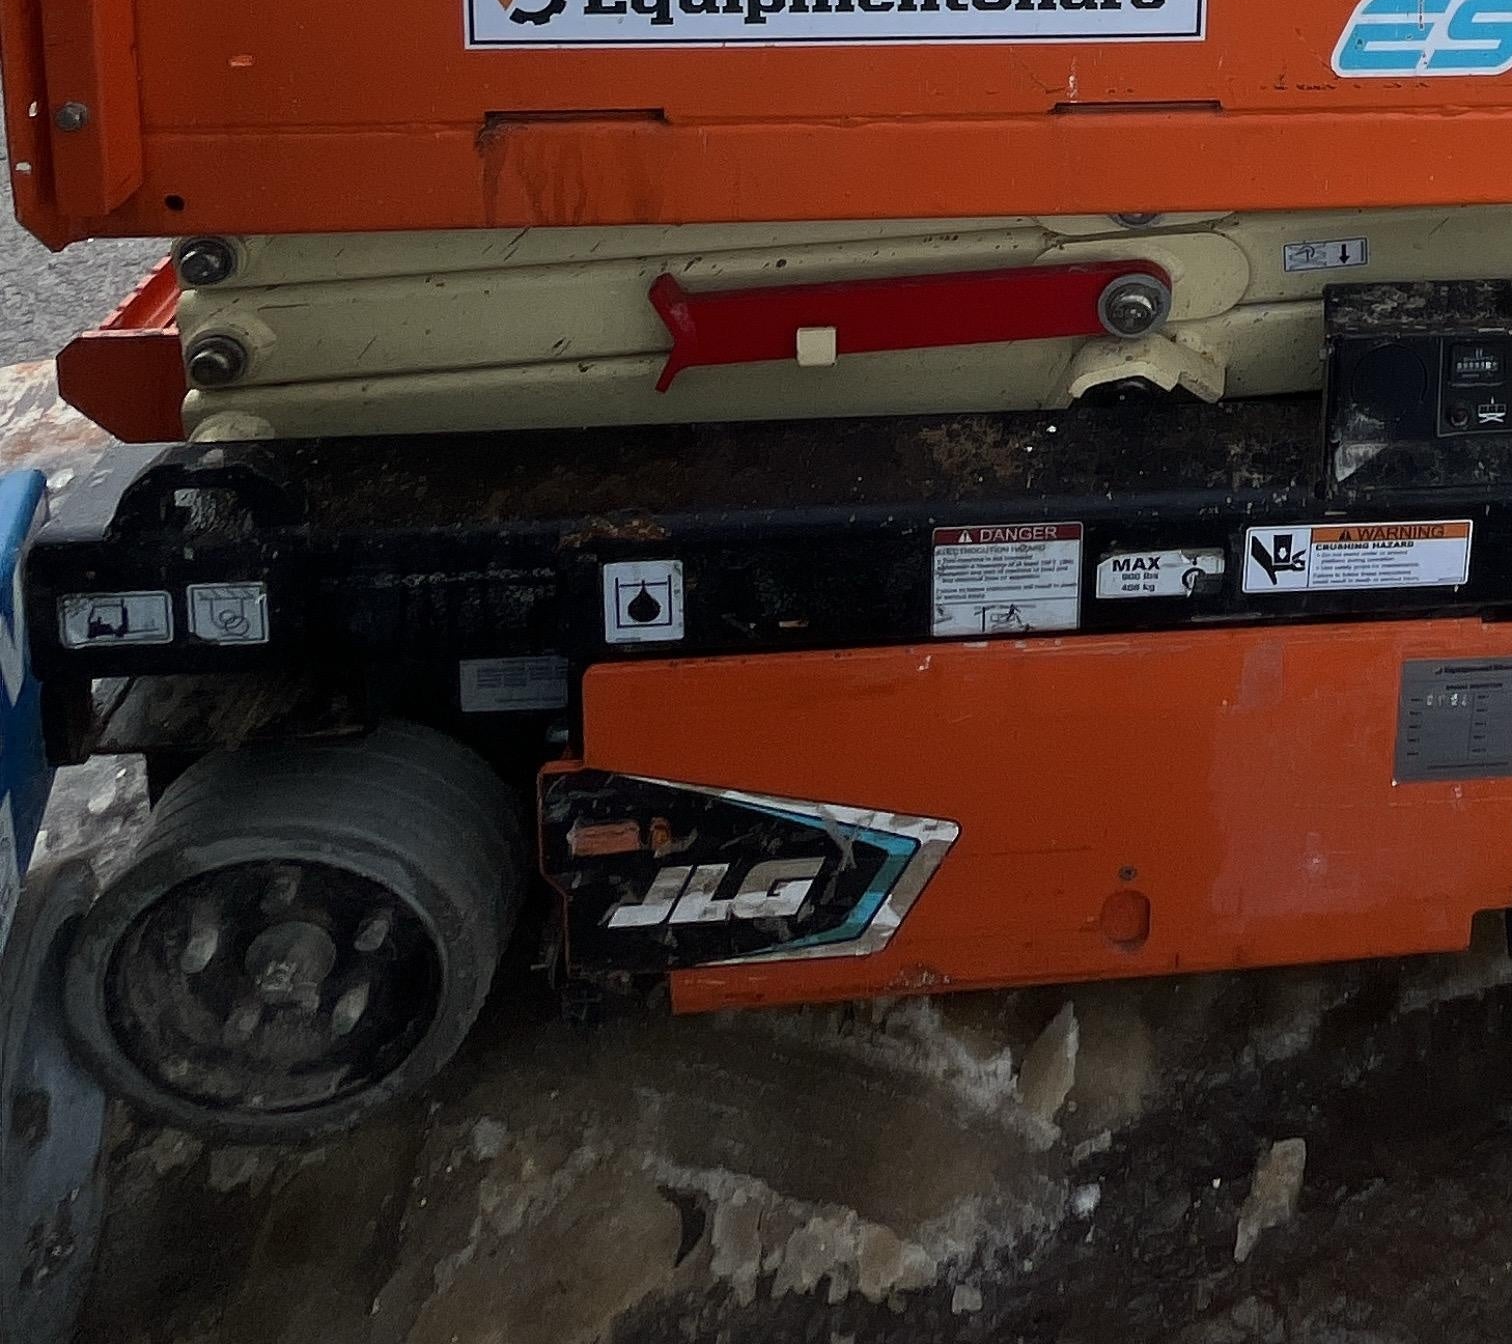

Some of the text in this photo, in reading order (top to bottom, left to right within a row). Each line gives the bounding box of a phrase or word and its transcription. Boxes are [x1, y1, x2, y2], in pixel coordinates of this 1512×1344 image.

[979, 526, 1058, 543] DANGER
[1357, 525, 1445, 541] WARNING
[1315, 540, 1415, 551] CRUSHING HAZARD
[1112, 556, 1161, 572] MAX
[1142, 583, 1156, 592] kg
[606, 857, 826, 929] JLG
